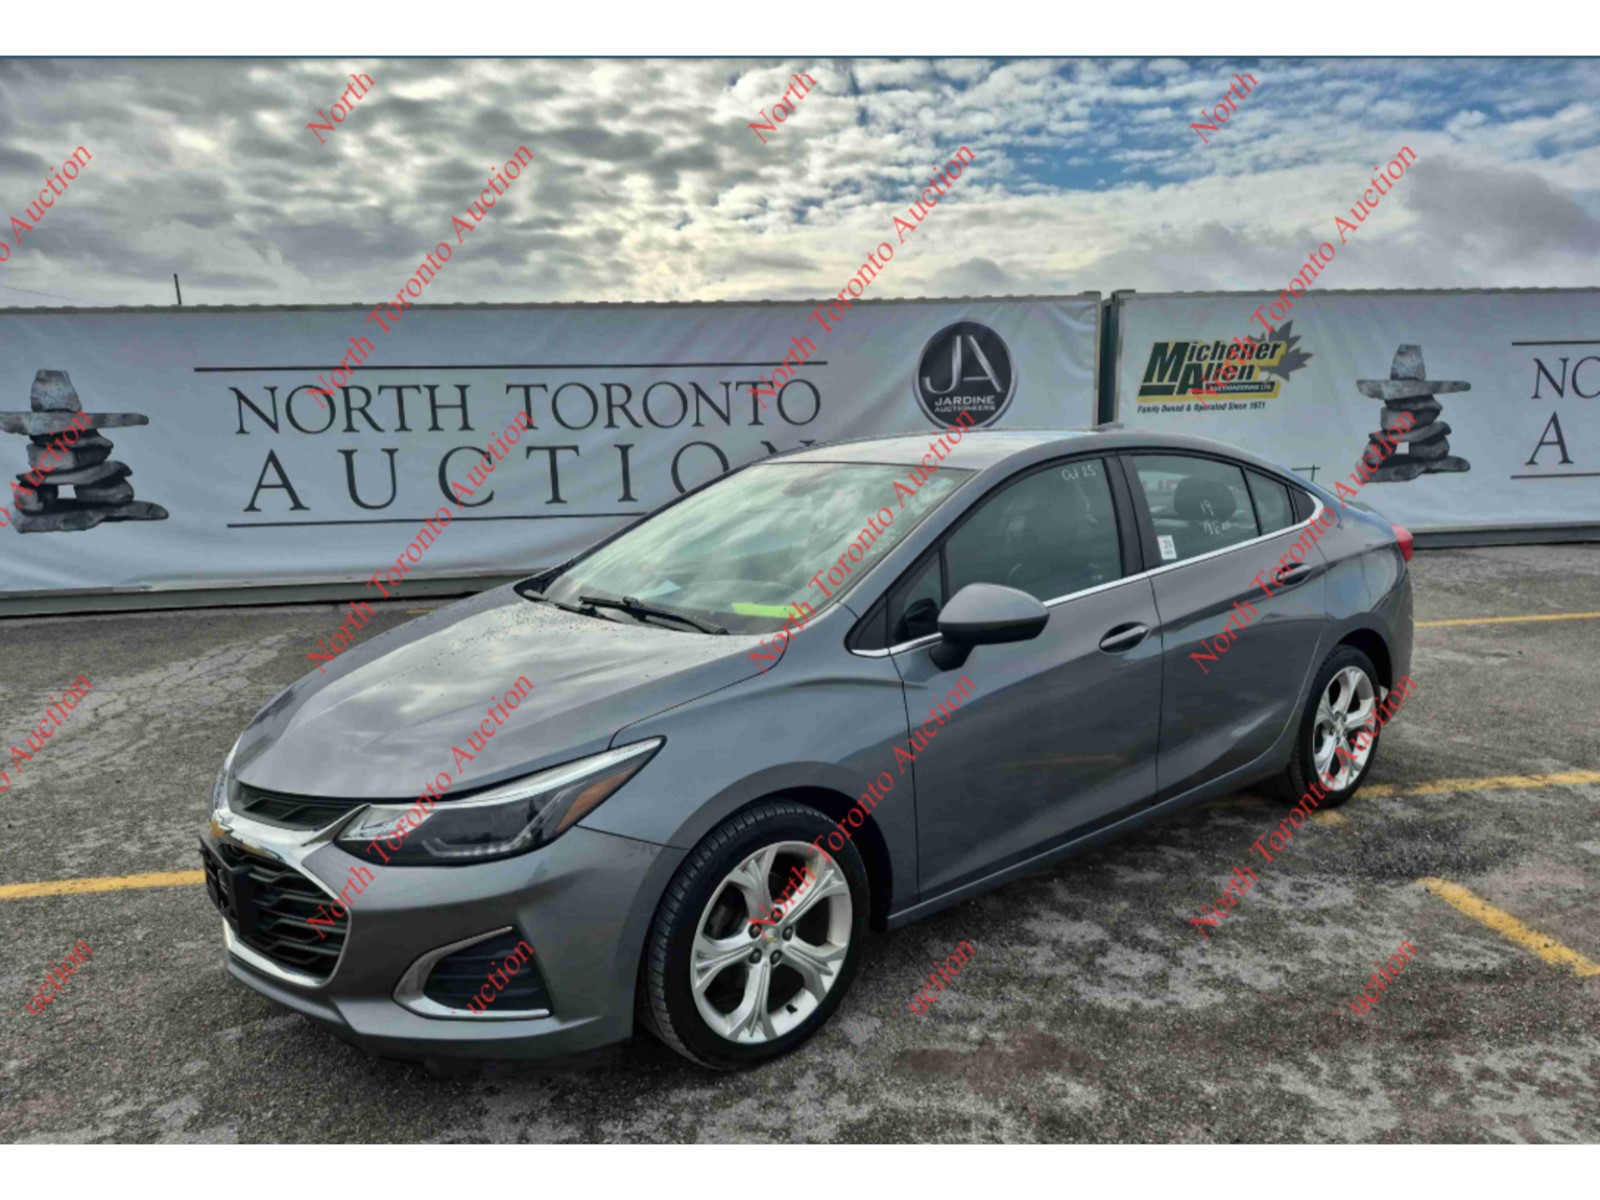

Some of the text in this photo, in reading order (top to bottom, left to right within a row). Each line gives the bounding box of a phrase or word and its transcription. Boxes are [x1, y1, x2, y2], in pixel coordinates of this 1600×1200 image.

[925, 335, 1004, 394] JA
[1143, 340, 1282, 383] Michener
[229, 378, 821, 434] NORTH TORONTO
[934, 395, 996, 407] JARDINE
[934, 405, 996, 413] AUCTIONEERS
[1137, 404, 1160, 414] Family
[1161, 404, 1184, 412] Owned
[1193, 402, 1227, 413] Operated
[1228, 402, 1248, 411] Since
[243, 440, 816, 512] AUCTIO
